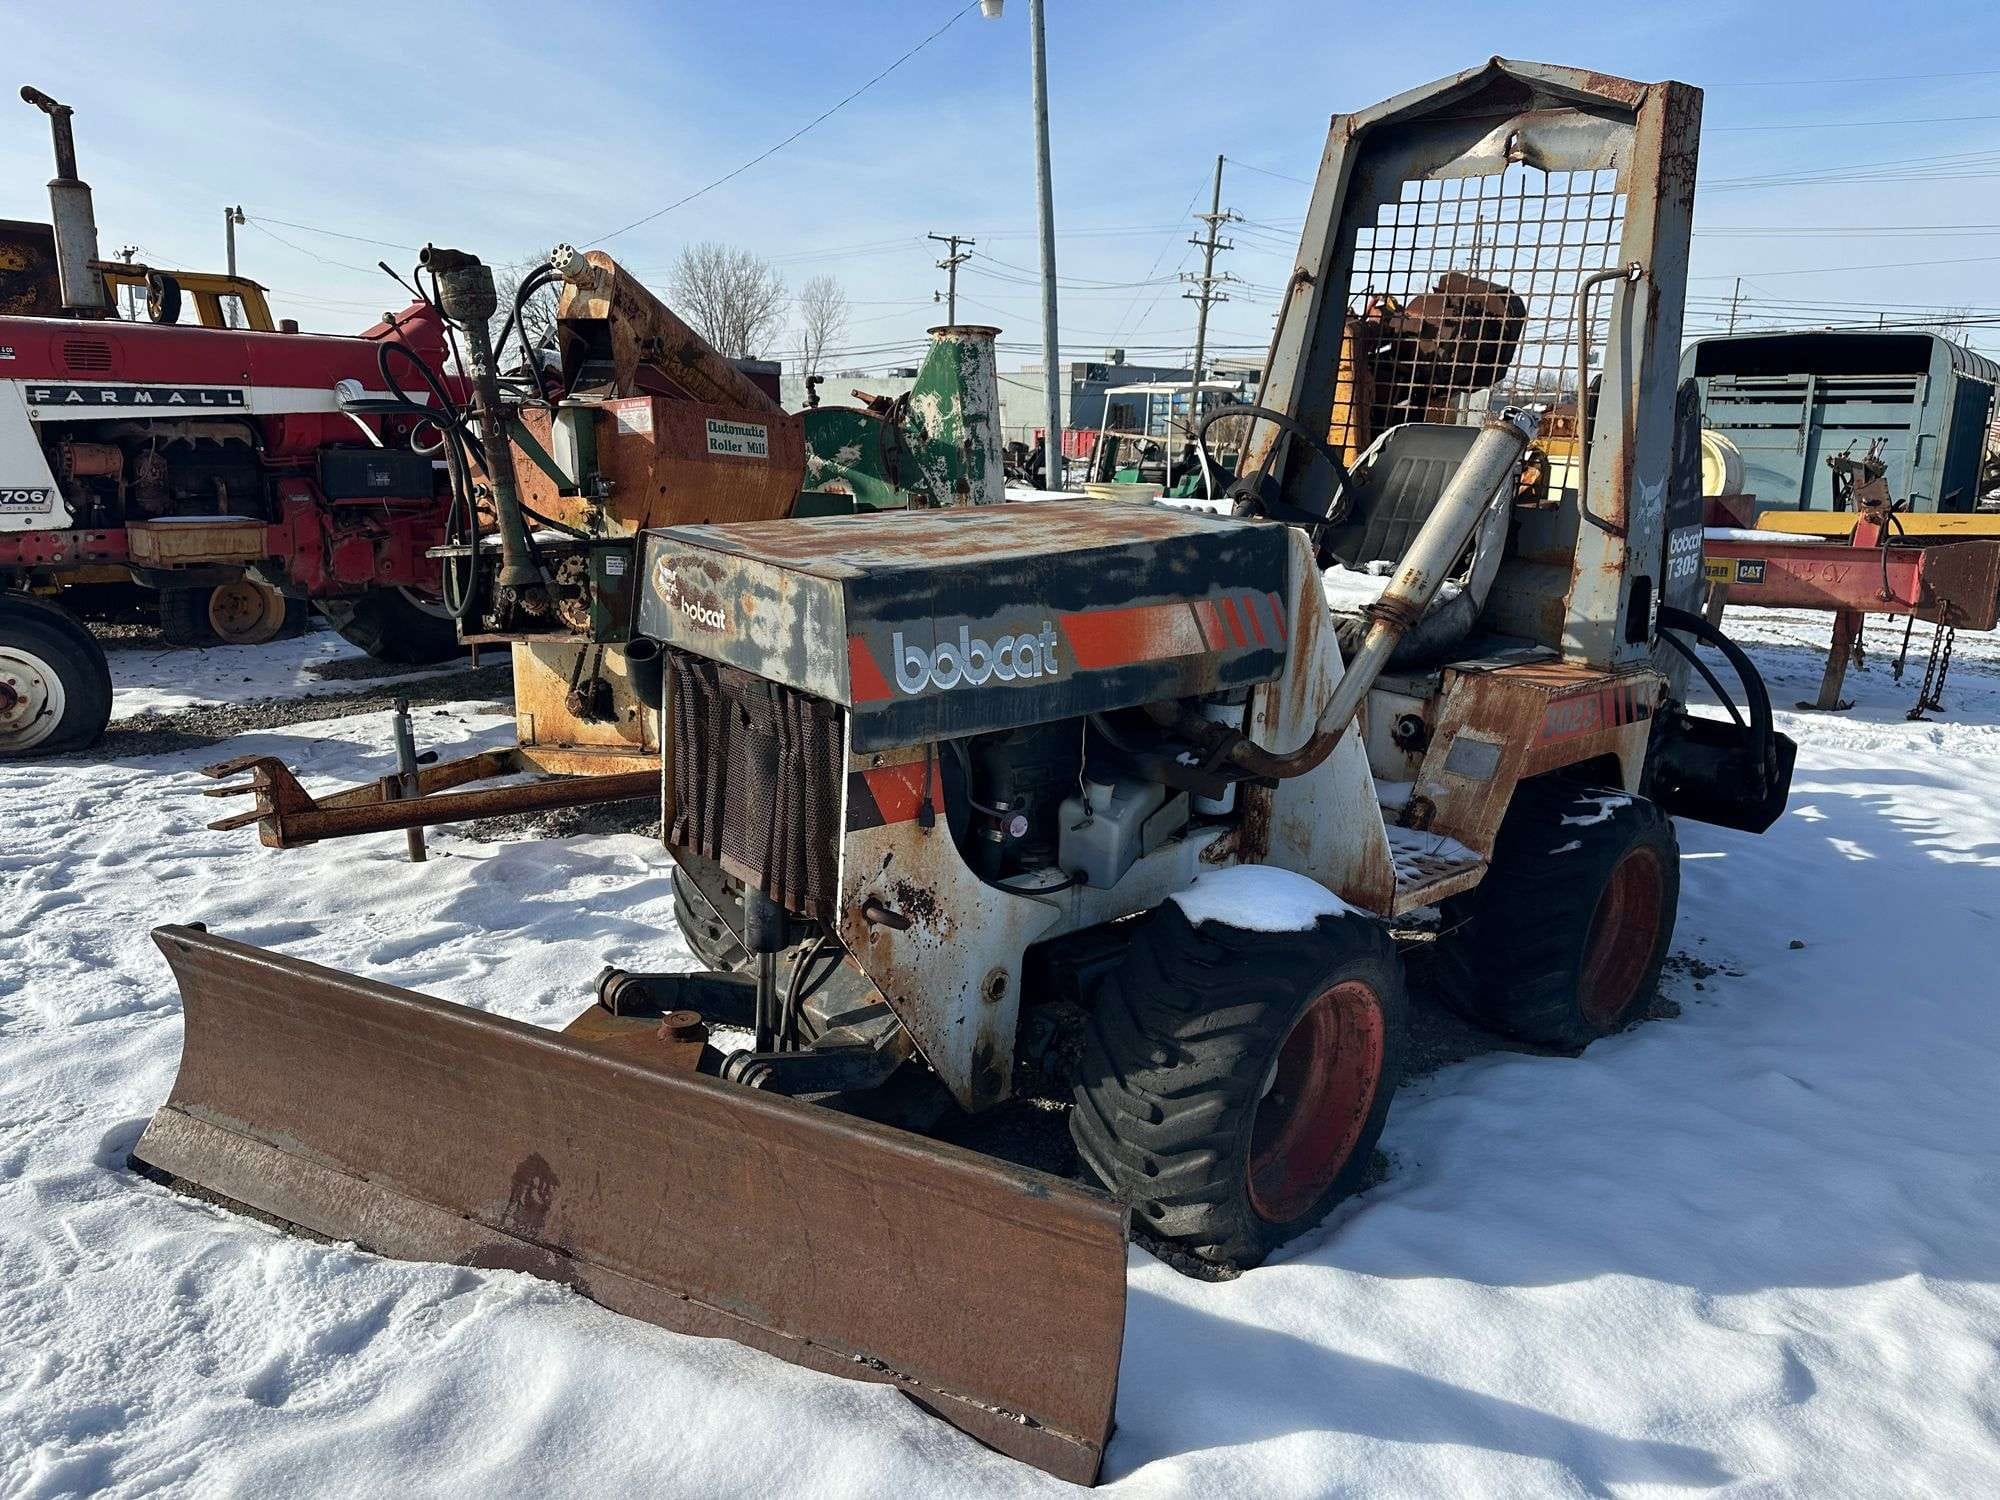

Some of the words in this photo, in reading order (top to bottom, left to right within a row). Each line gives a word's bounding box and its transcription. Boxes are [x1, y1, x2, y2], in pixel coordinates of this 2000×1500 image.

[34, 389, 241, 404] FARMALL
[708, 420, 765, 438] Automatic
[710, 438, 742, 453] Roller
[1, 490, 44, 503] 706
[1670, 529, 1702, 554] bobcat
[1740, 565, 1762, 578] CAT
[681, 595, 726, 630] bobcat
[893, 621, 1058, 695] bobcat
